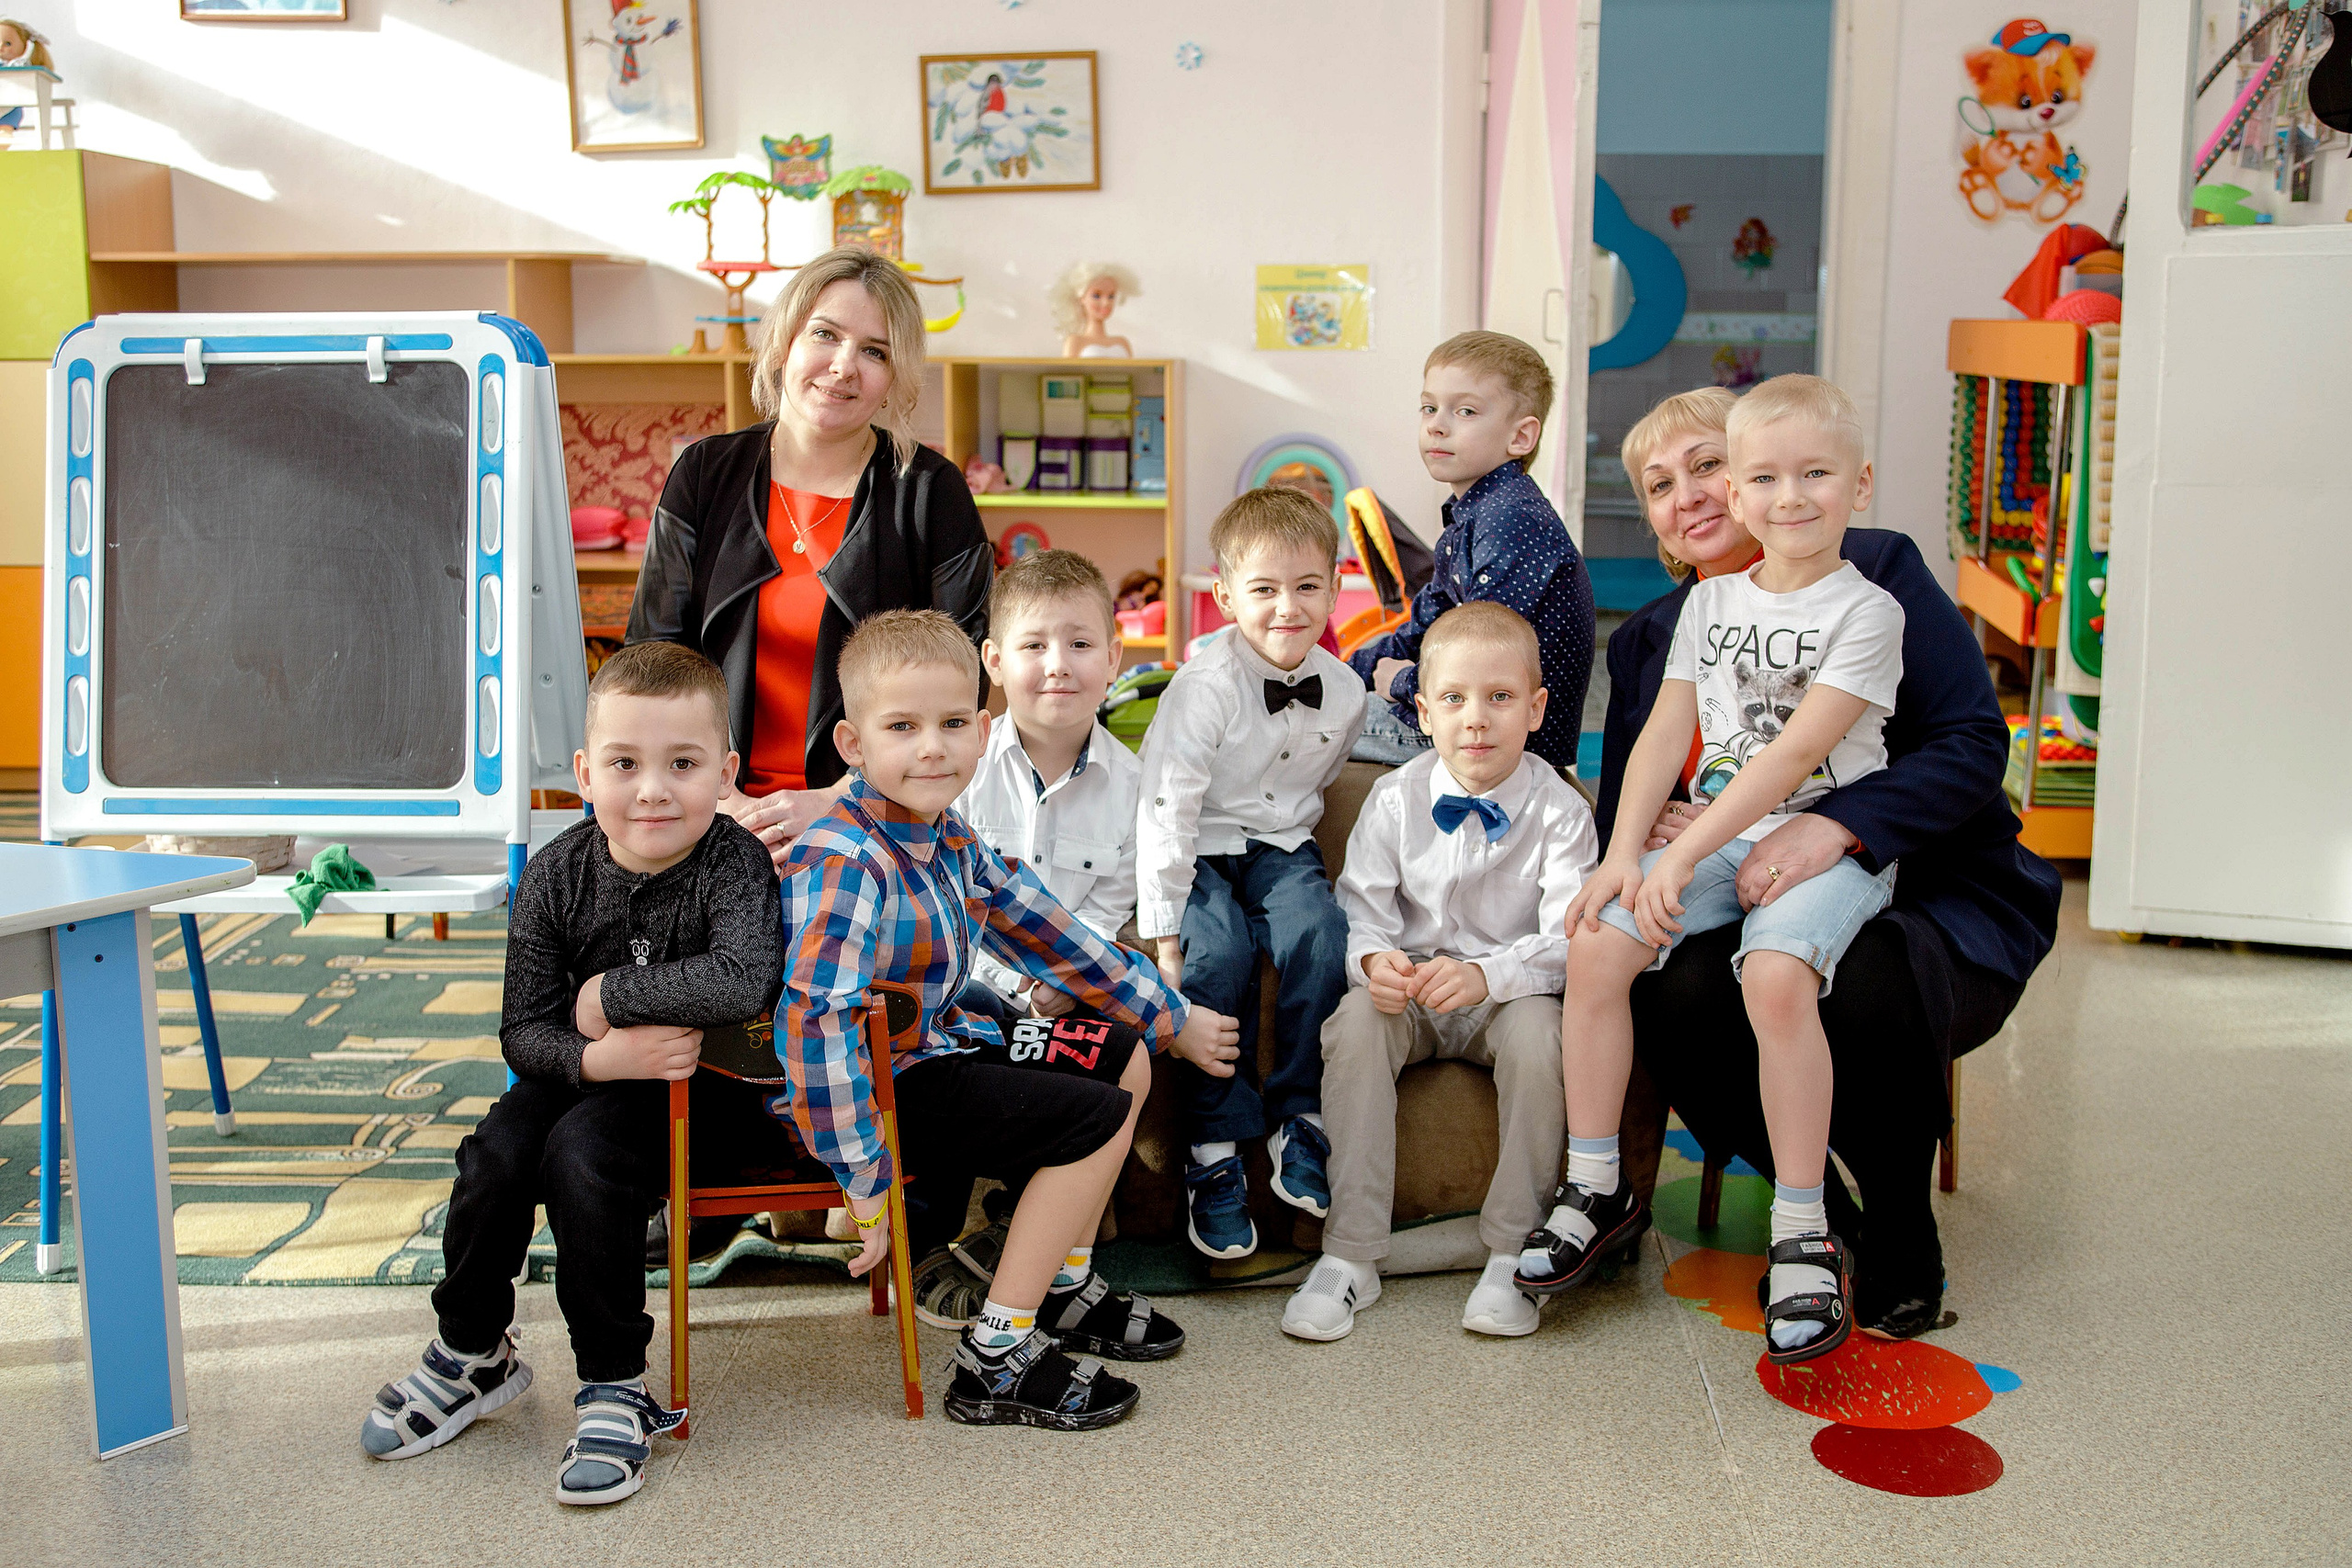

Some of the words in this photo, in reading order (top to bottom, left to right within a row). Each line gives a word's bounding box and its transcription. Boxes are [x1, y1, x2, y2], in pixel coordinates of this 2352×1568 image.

[1700, 623, 1821, 671] SPACE
[1046, 1018, 1114, 1071] ZE
[978, 1312, 1012, 1332] SMILE
